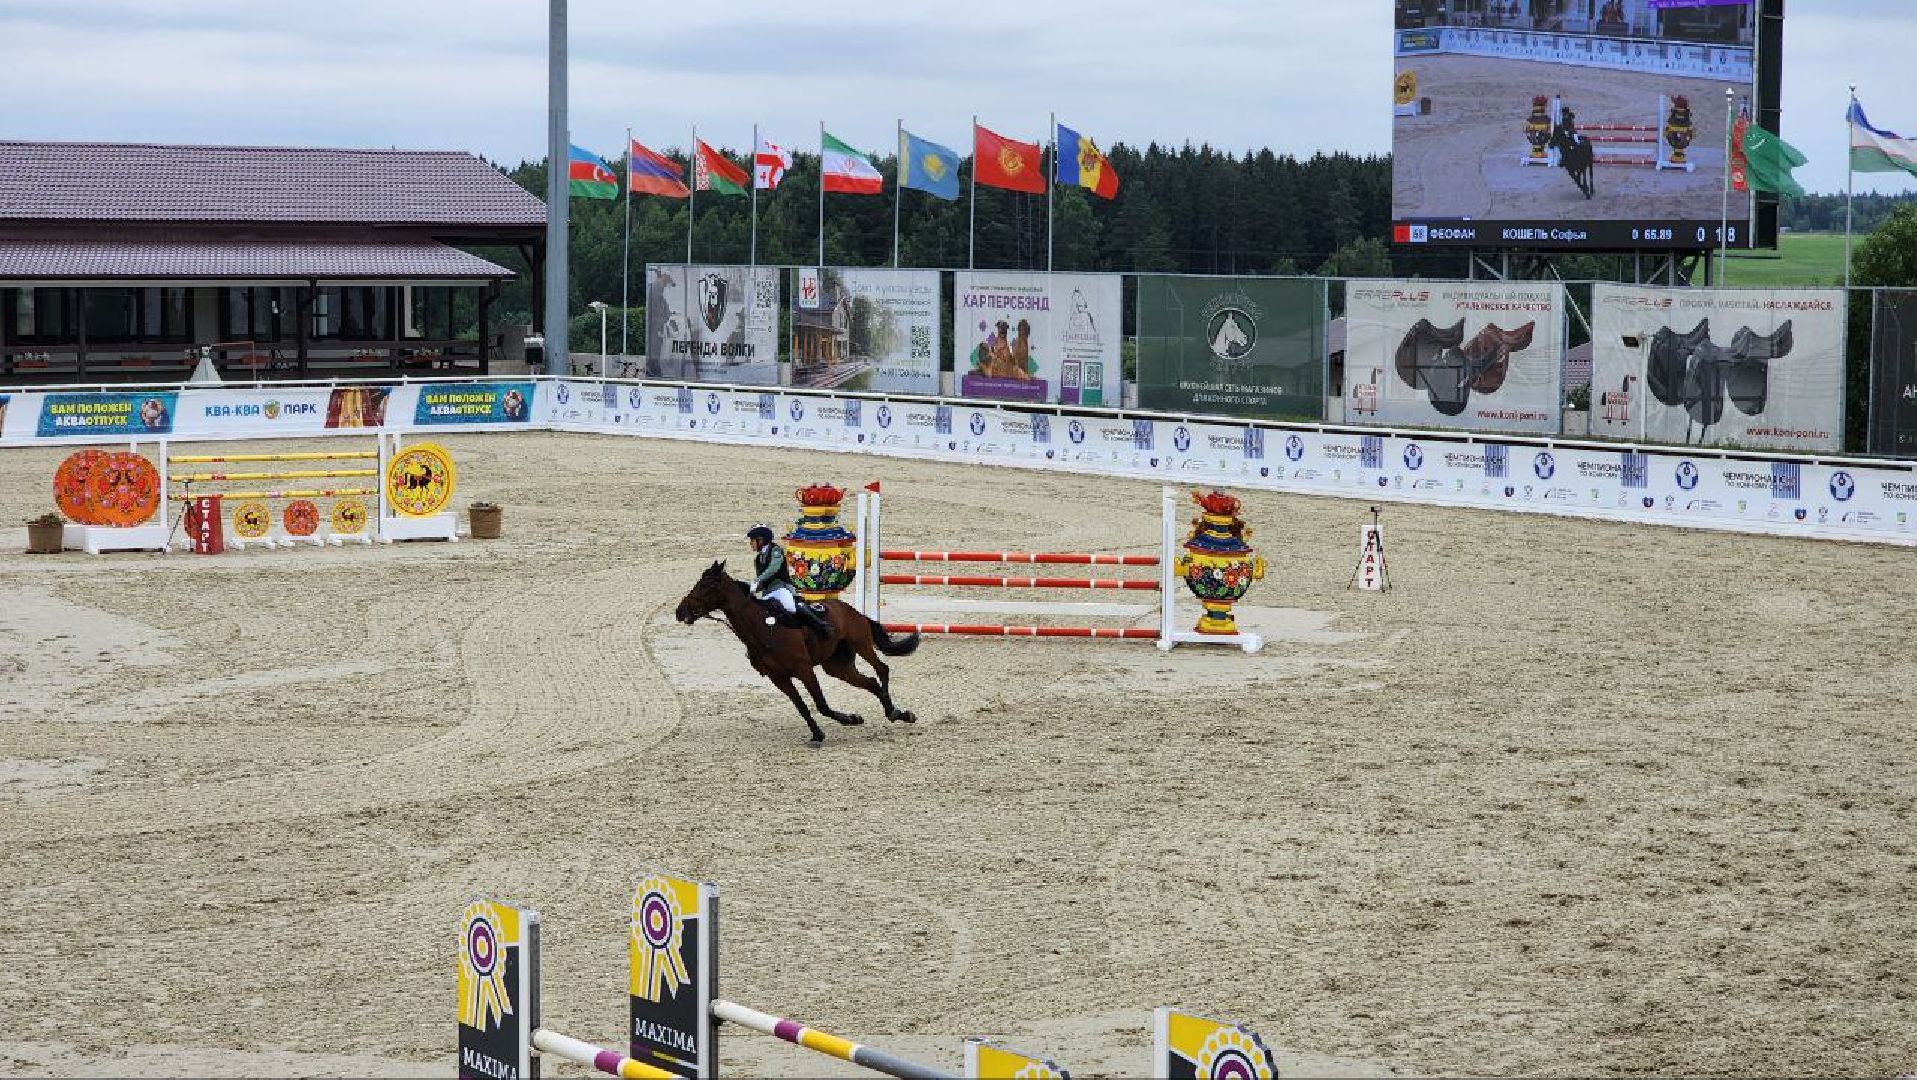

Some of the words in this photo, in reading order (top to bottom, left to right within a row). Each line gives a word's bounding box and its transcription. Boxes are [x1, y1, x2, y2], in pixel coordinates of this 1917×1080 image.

[1430, 228, 1476, 240] ФЕОФАН
[1502, 228, 1548, 240] КОШЕЛЬ
[1550, 228, 1587, 242] Софья
[672, 340, 718, 357] ЛЕГЕНДА
[721, 343, 755, 357] ВОЛГИ
[51, 404, 75, 415] ВАМ
[284, 403, 317, 414] ПАРК
[55, 415, 128, 426] АКВАОТПУСК
[1746, 426, 1830, 440] www.koni-poni.ru
[201, 498, 210, 552] СТАРТ
[1364, 530, 1376, 587] СТАРТ
[635, 1017, 696, 1053] MAXIMA
[463, 1046, 518, 1080] MAXIMA
